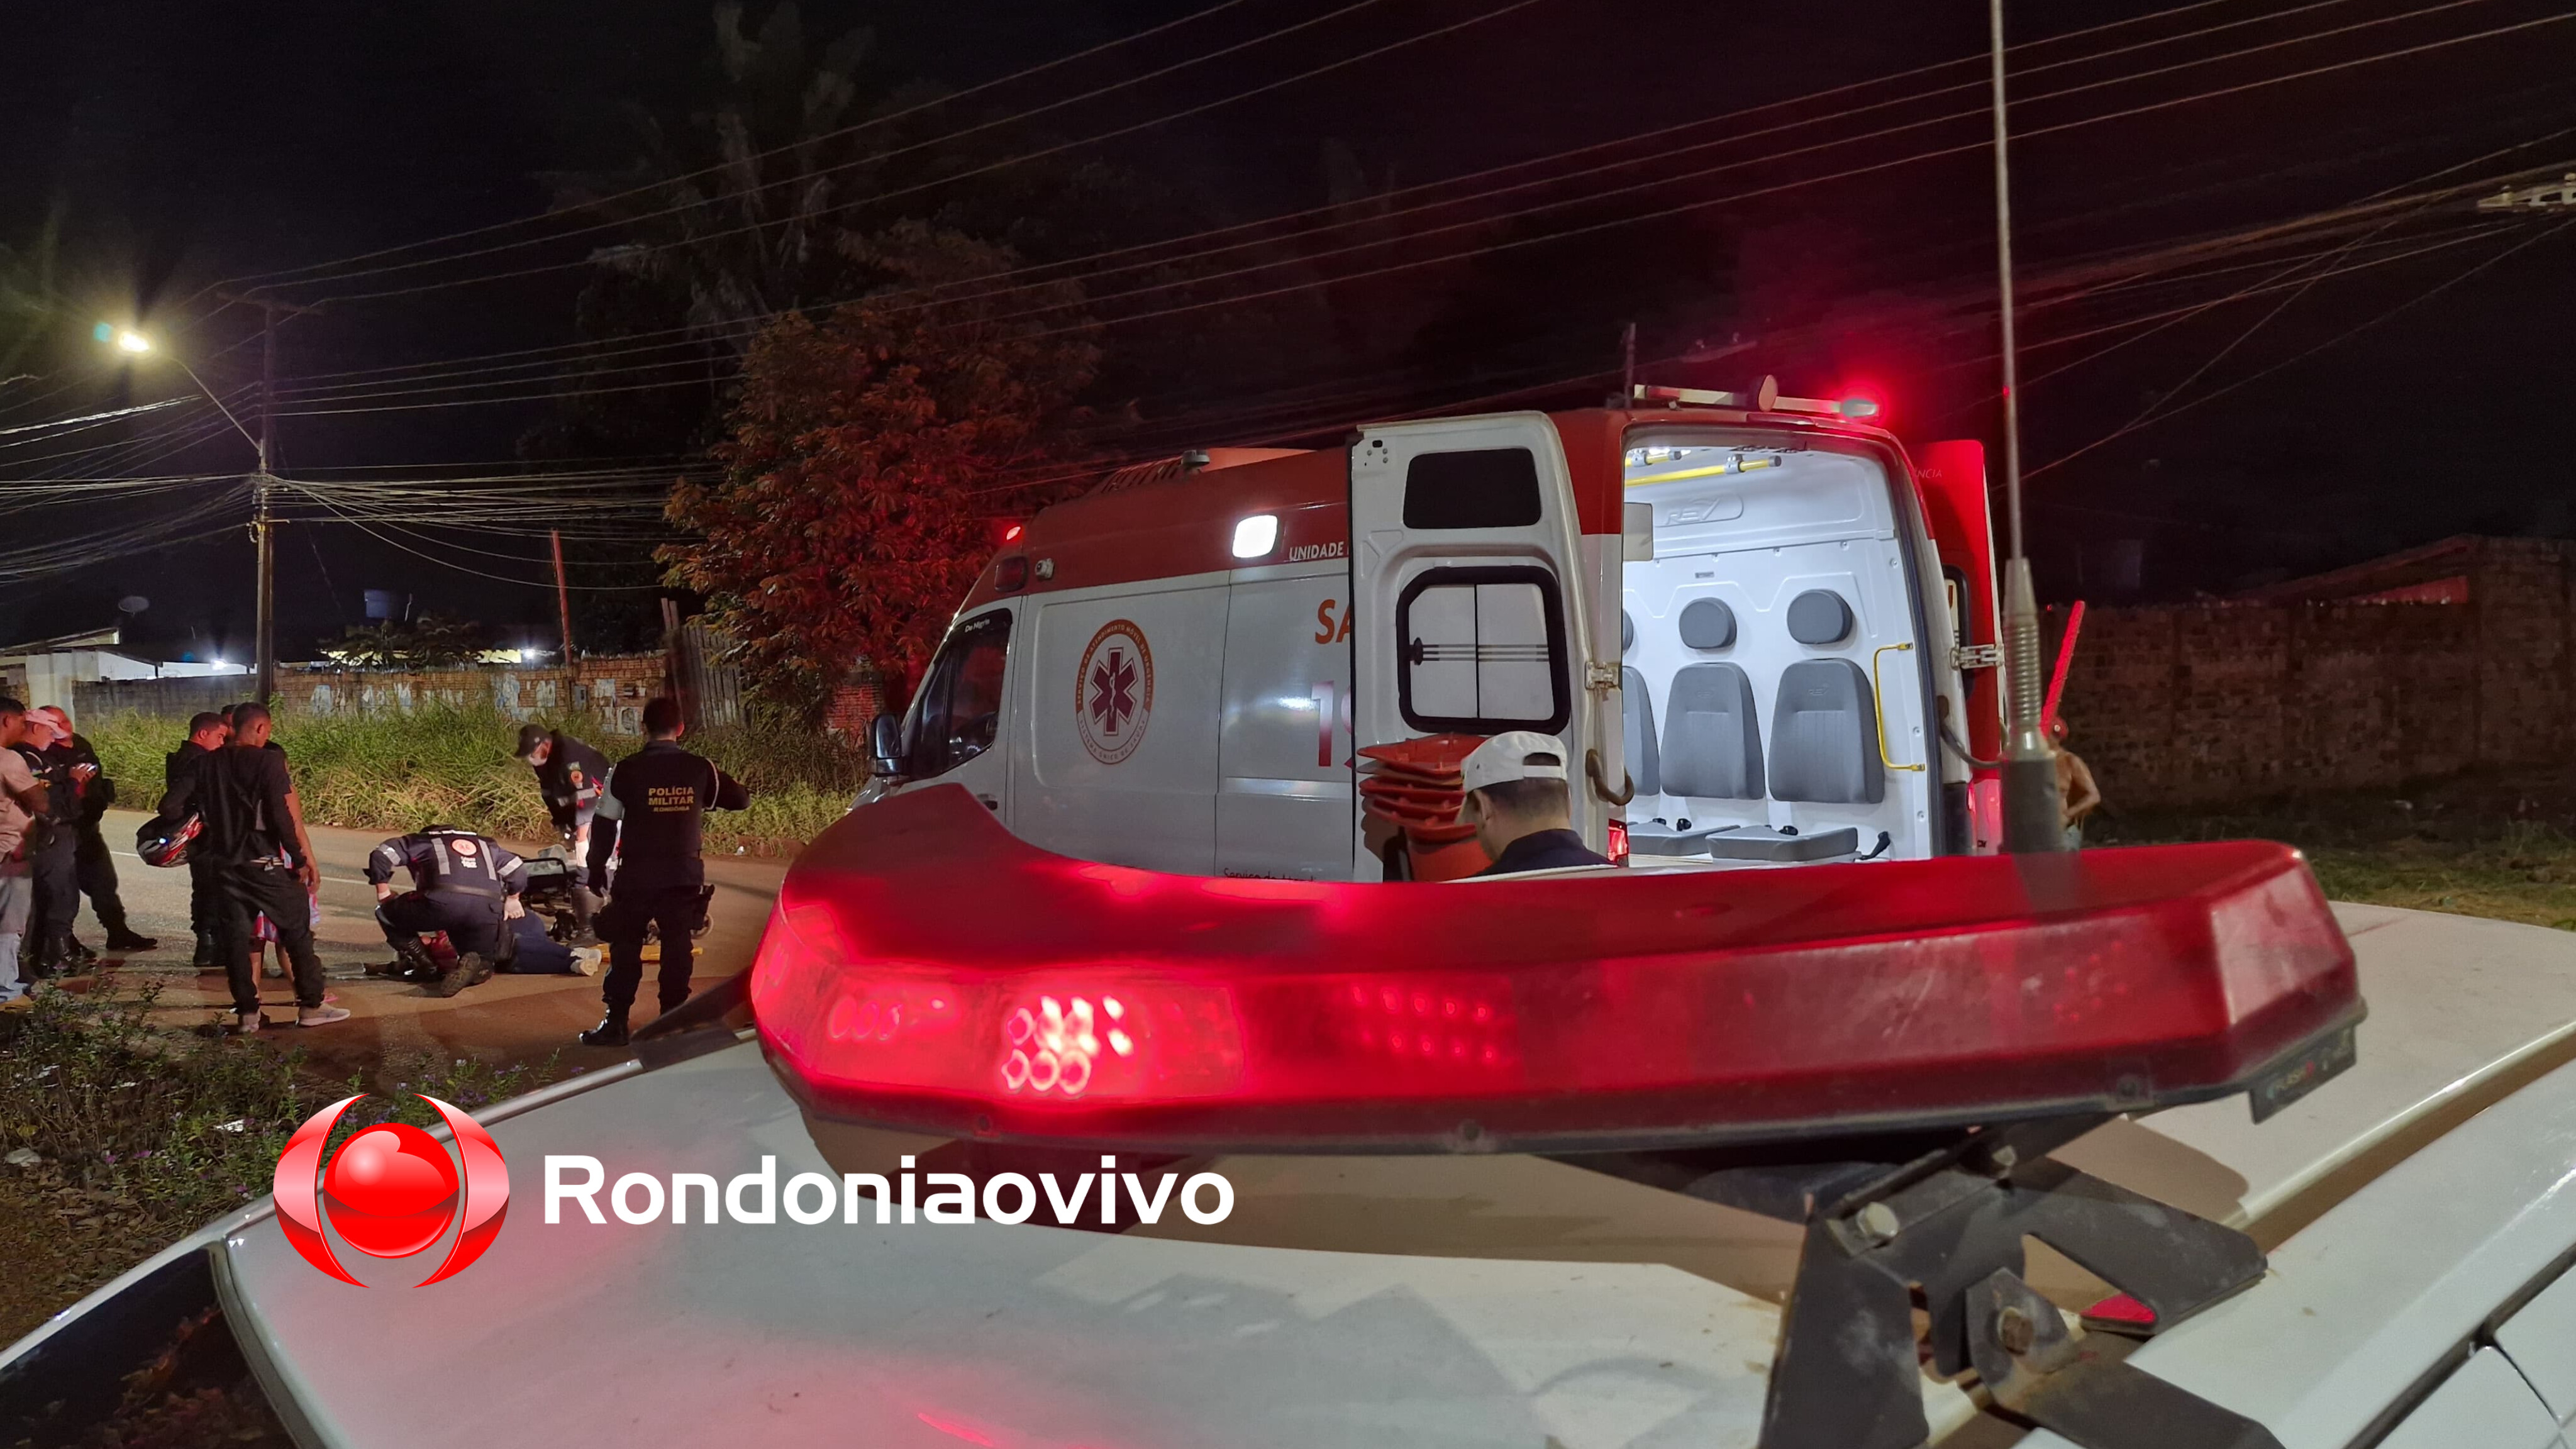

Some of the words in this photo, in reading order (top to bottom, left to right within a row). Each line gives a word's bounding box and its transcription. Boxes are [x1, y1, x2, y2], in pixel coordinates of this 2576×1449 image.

[1289, 541, 1344, 561] UNIDADE
[1089, 624, 1124, 652] ATENDIMENTO
[648, 786, 694, 796] POLÍCIA
[648, 796, 694, 805] MILITAR
